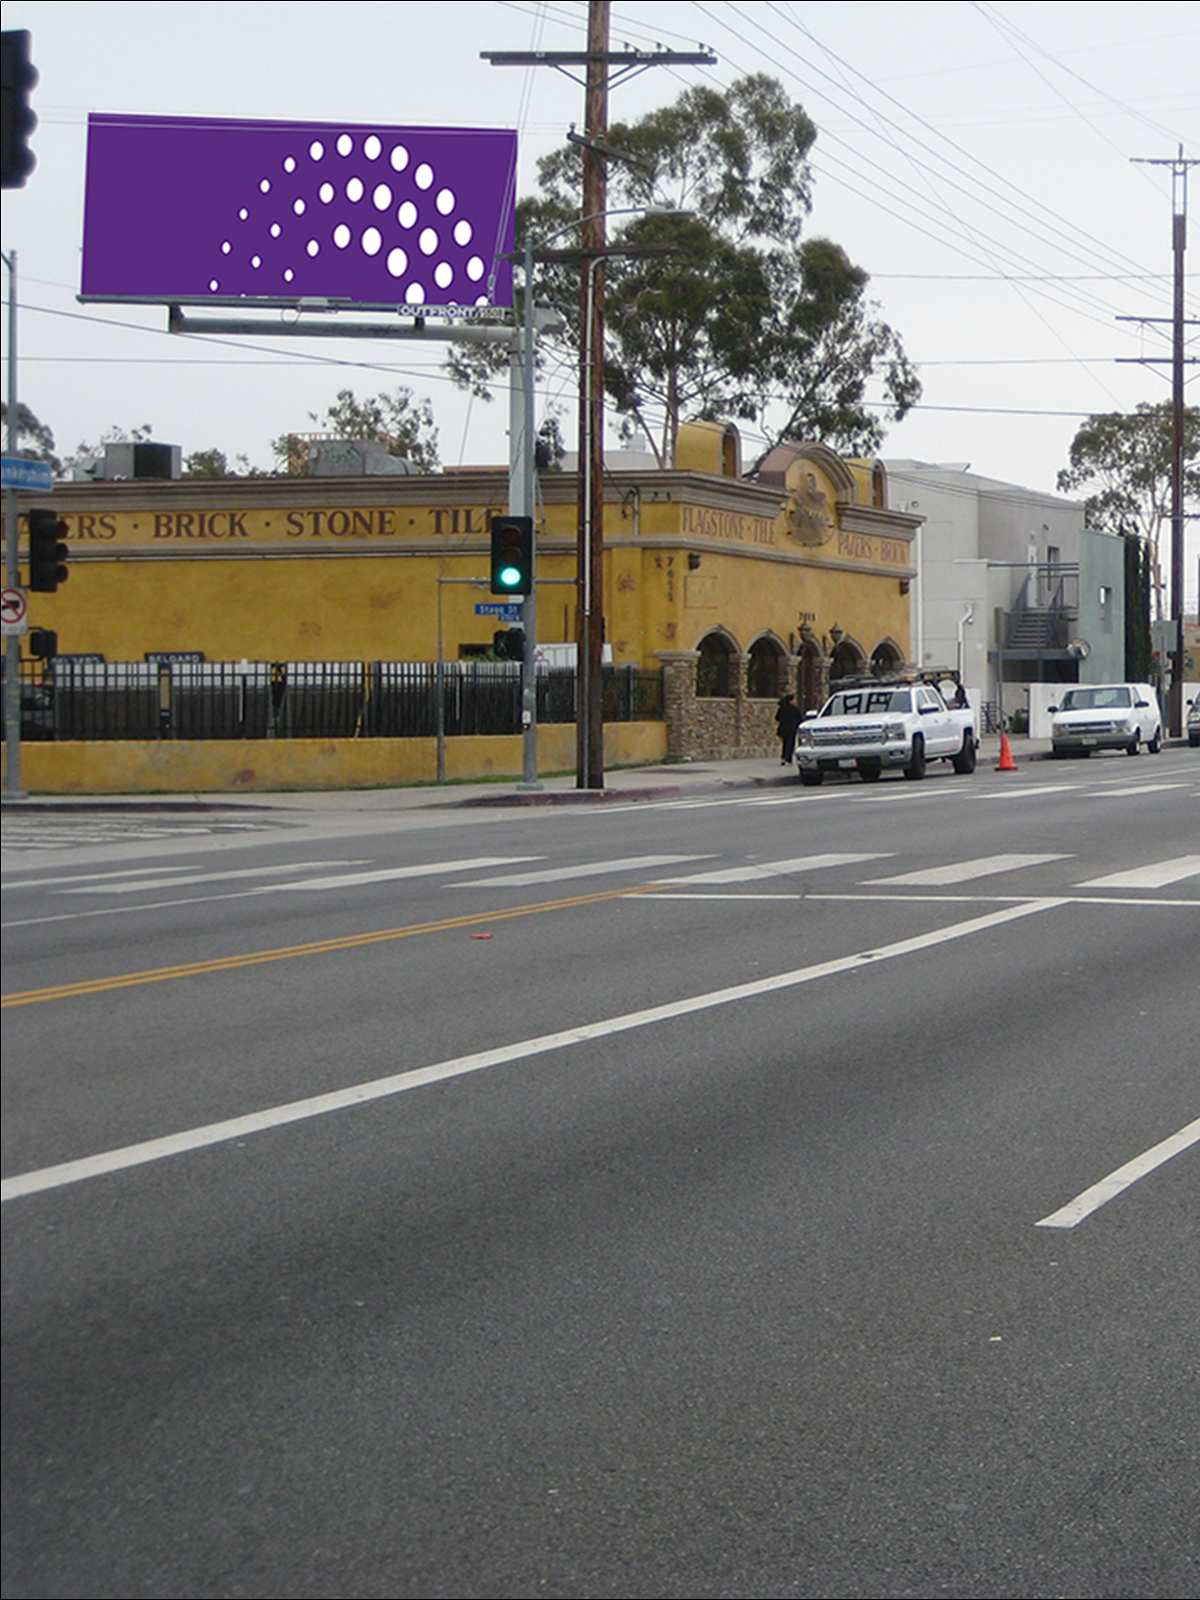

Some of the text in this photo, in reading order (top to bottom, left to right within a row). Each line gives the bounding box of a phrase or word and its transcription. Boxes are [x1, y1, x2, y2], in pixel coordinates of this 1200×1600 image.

[153, 512, 249, 539] BRICK
[286, 510, 396, 537] STONE
[682, 506, 775, 544] FLAGSTONE TILE
[480, 605, 518, 615] Stagg St
[149, 655, 201, 664] BELGARD
